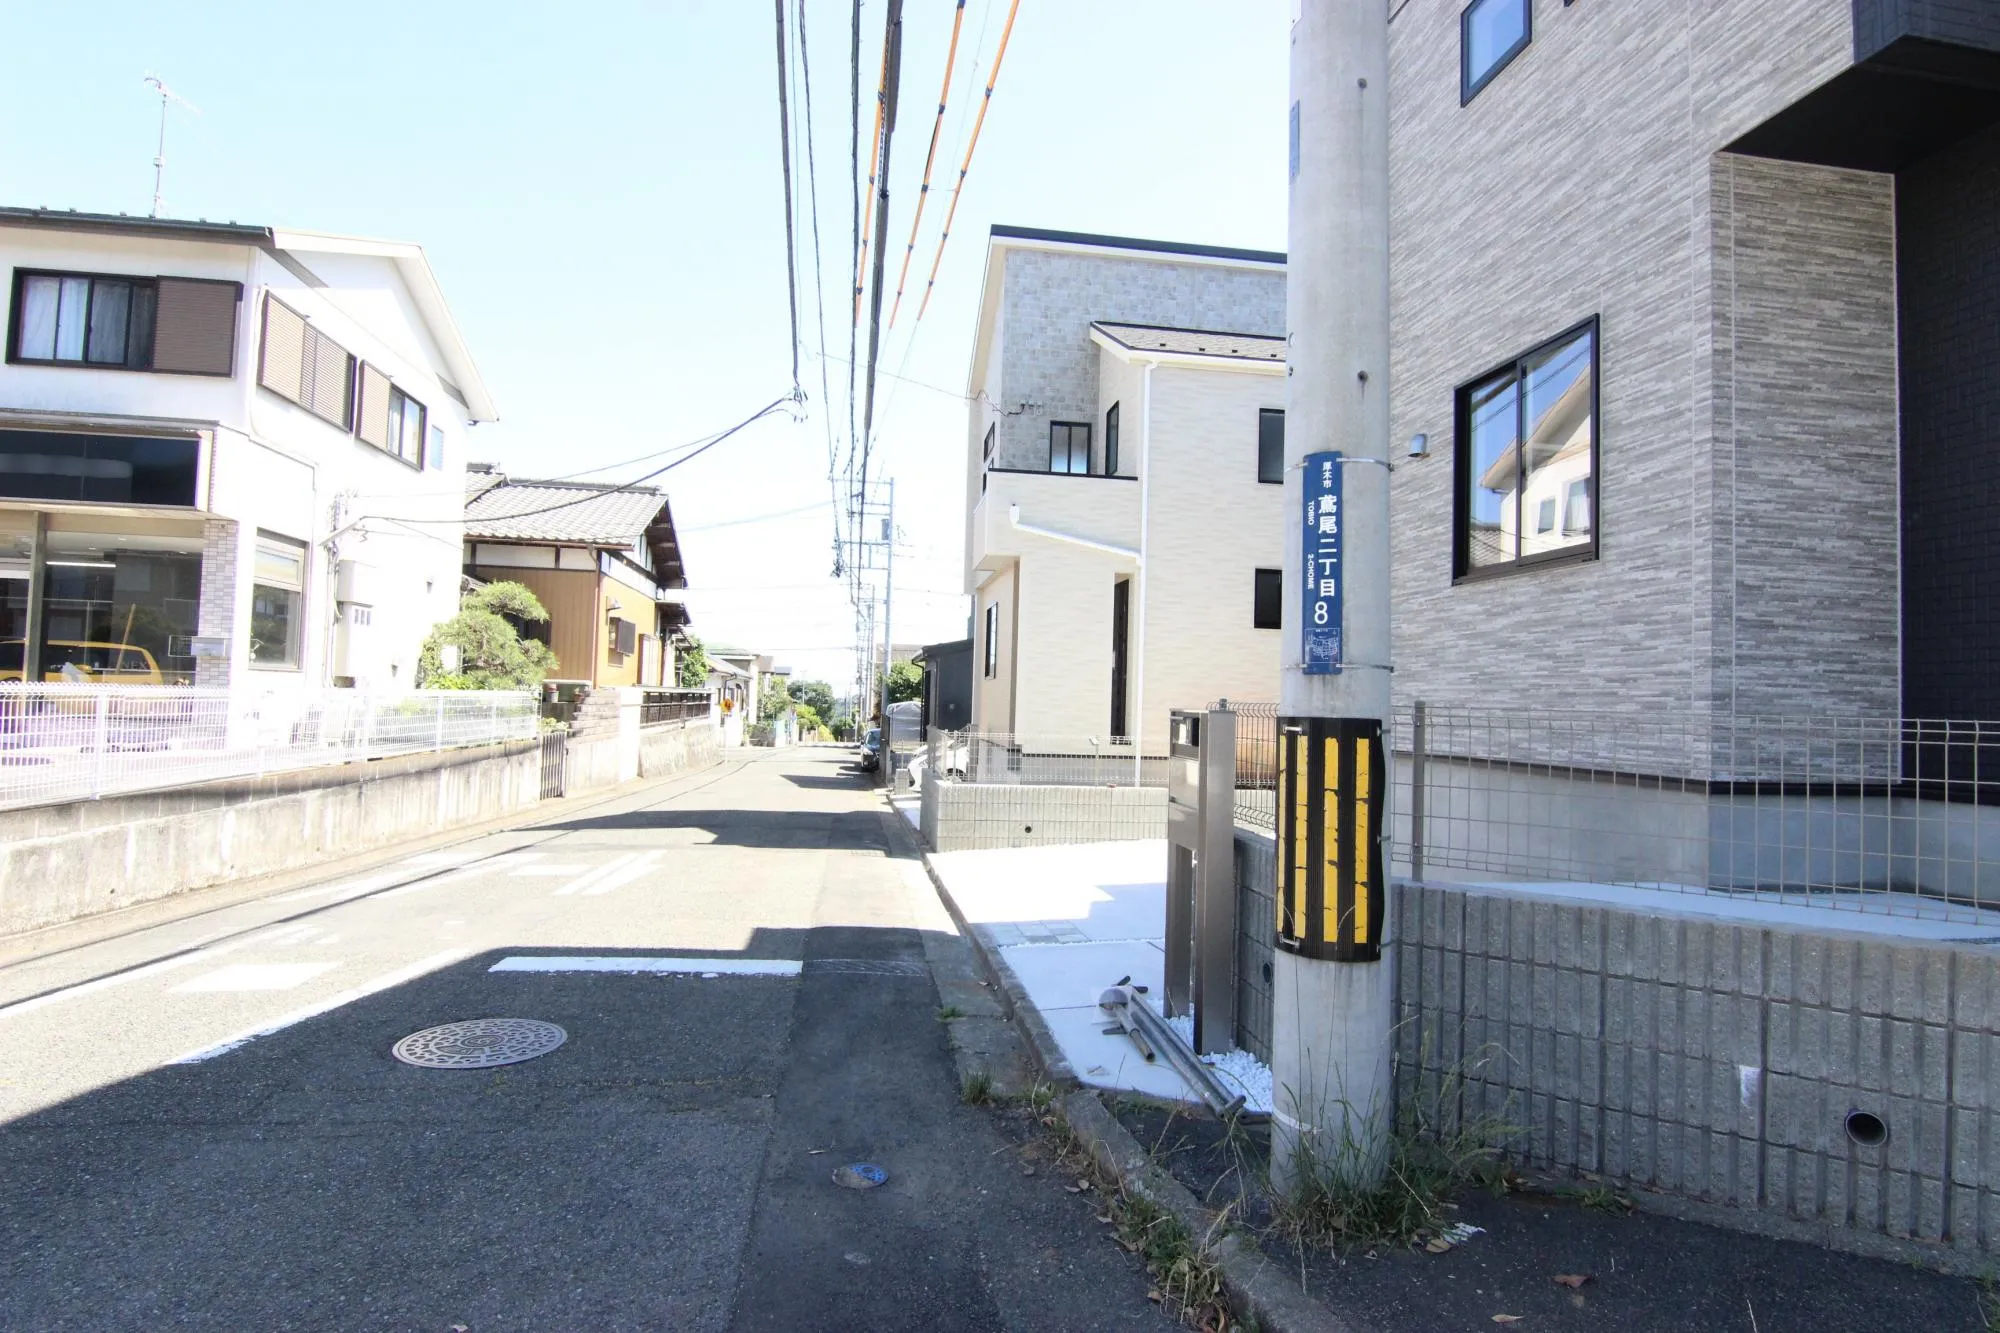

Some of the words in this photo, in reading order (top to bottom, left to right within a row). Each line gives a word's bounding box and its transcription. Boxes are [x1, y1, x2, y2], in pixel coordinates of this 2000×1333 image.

[1322, 462, 1332, 488] 厚木市
[1318, 494, 1337, 597] 鳶尾二丁目
[1314, 601, 1328, 625] 8
